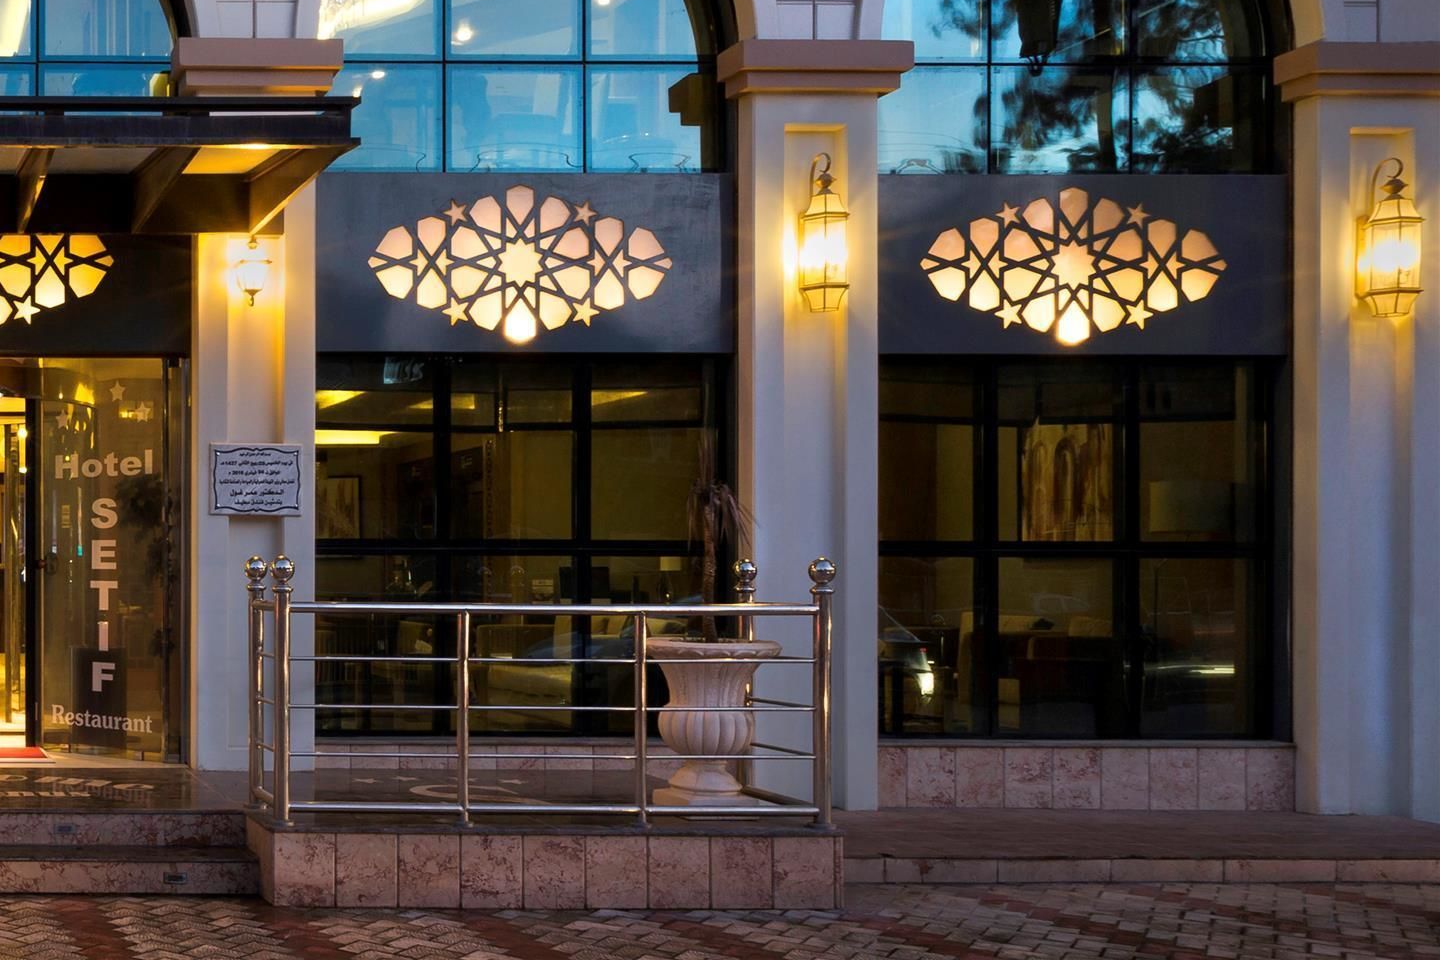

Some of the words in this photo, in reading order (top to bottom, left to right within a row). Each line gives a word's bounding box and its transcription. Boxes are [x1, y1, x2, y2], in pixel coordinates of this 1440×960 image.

[54, 448, 153, 480] Hotel
[90, 497, 119, 692] SETIF
[51, 704, 153, 734] Restaurant
